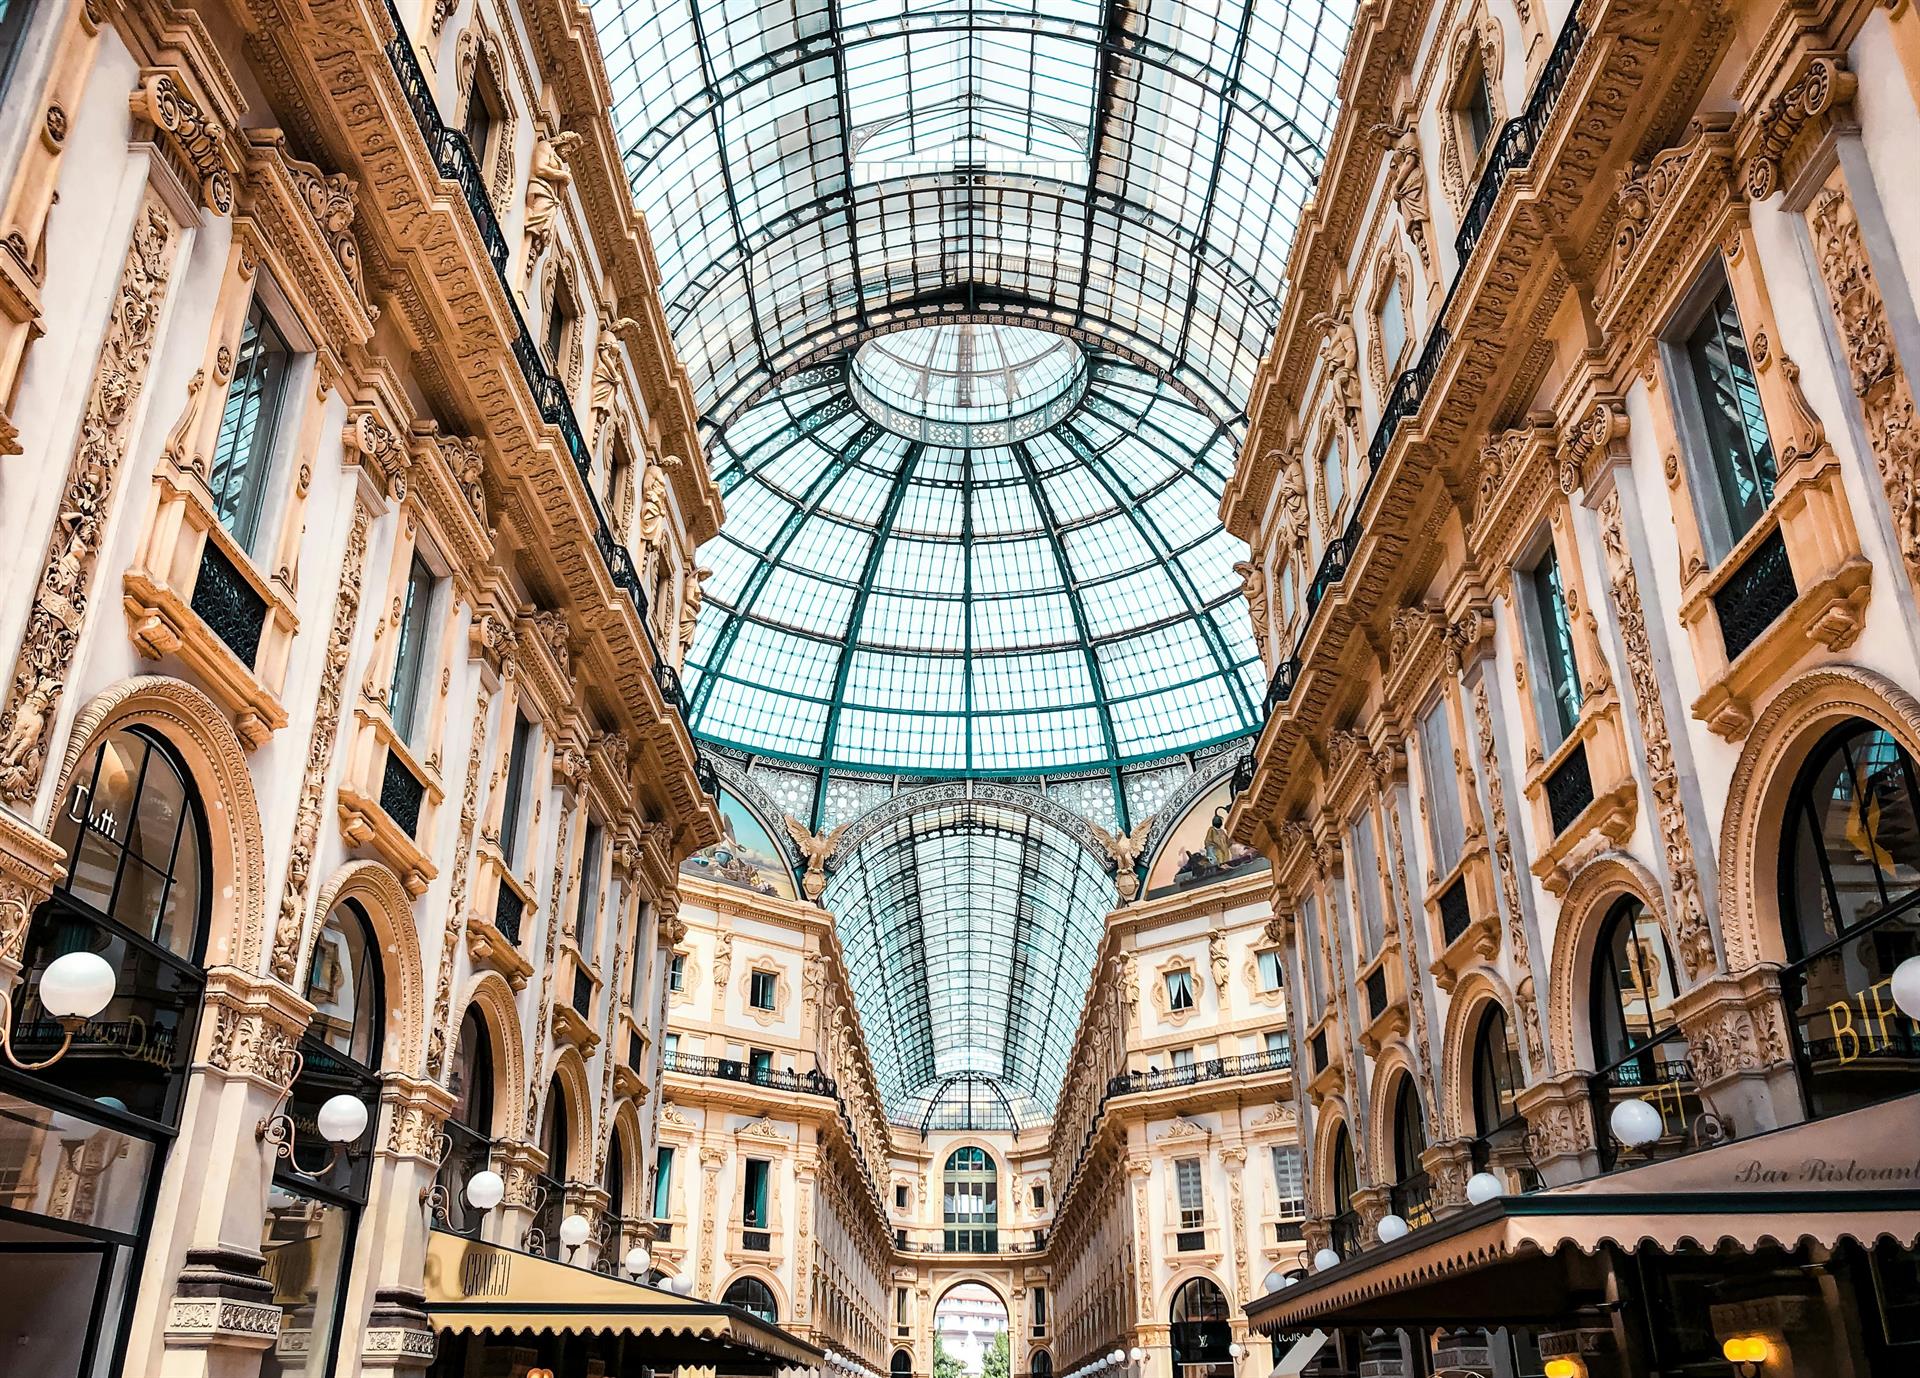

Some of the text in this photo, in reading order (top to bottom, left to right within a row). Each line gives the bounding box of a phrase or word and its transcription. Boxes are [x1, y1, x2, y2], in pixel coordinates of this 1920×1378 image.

[68, 784, 118, 839] Dutti
[1826, 976, 1920, 1066] BIF
[1735, 1159, 1790, 1184] Bar
[463, 1253, 512, 1297] CRACCO
